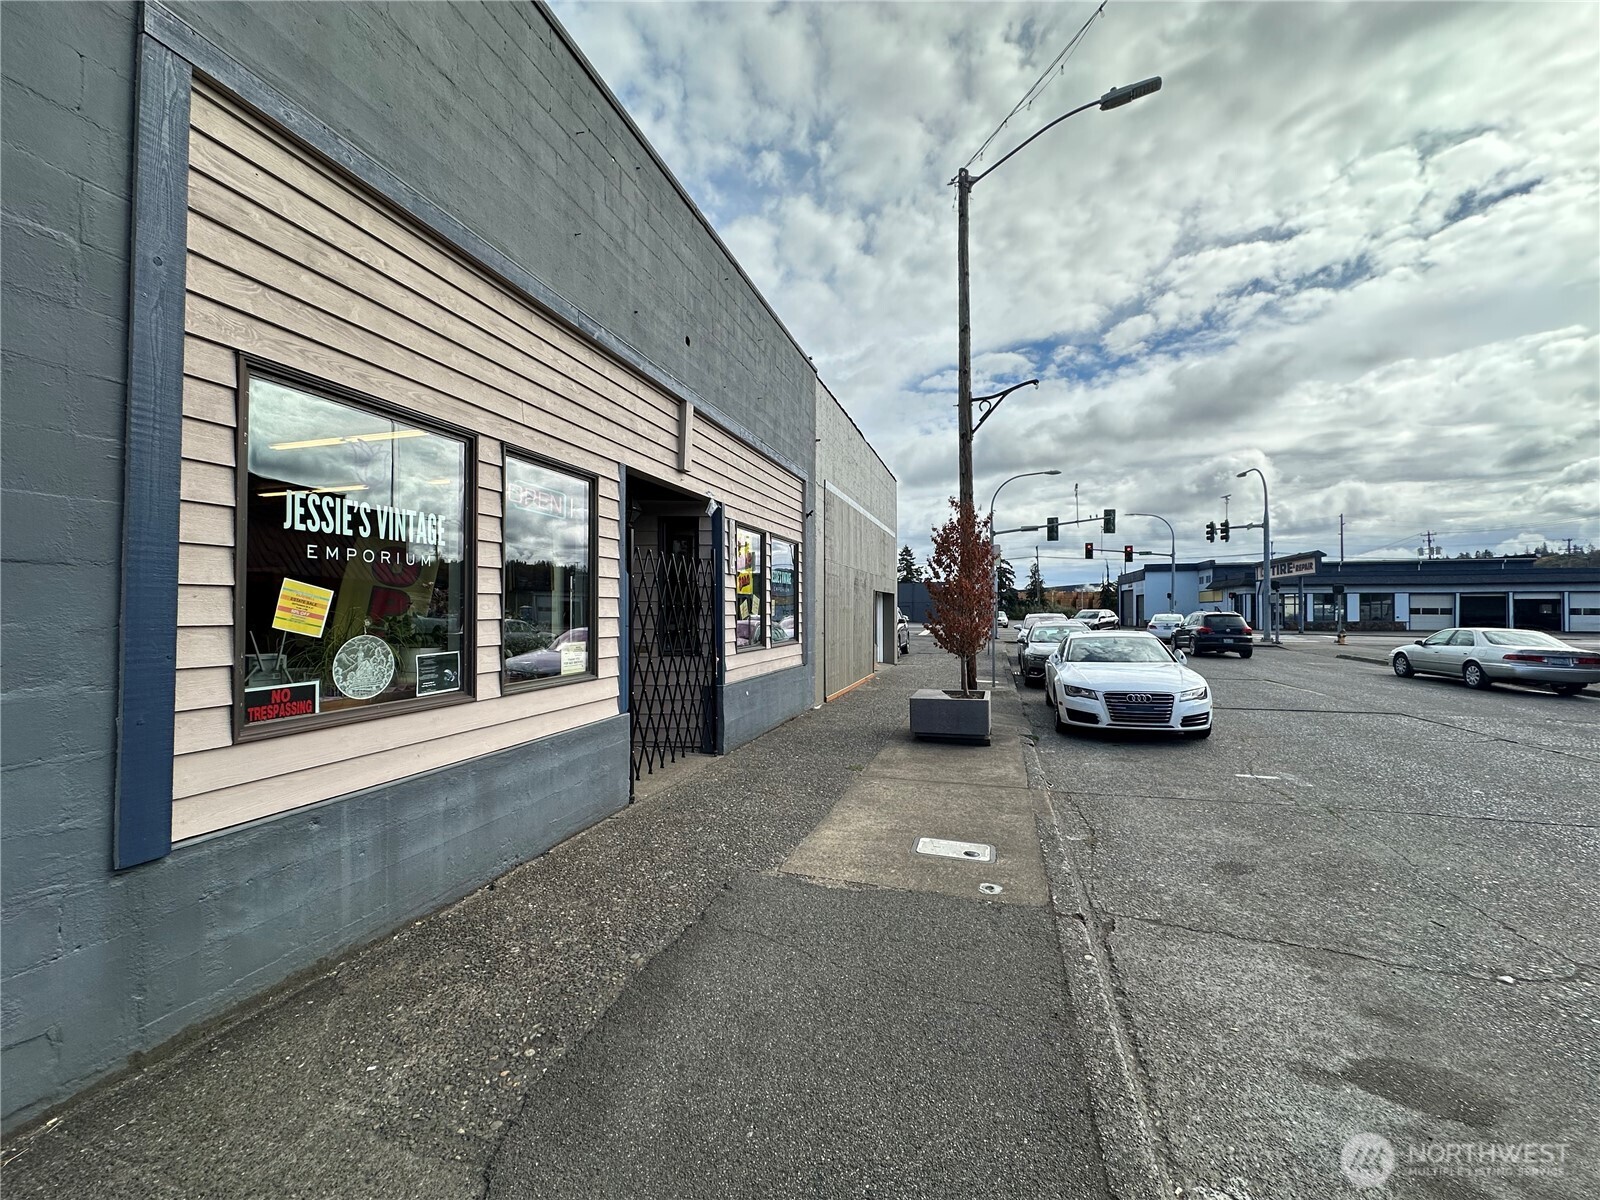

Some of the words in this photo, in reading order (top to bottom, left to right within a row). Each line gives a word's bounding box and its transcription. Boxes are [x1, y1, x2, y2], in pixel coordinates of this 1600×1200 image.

[508, 483, 562, 514] OPEN
[283, 489, 371, 538] JESSIE'S
[377, 504, 446, 546] VINTAGE
[306, 544, 431, 567] EMPORIUM
[1270, 562, 1293, 576] TIRE
[1295, 562, 1313, 572] REPAIR
[271, 688, 291, 704] NO
[247, 699, 312, 722] TRESPASSING
